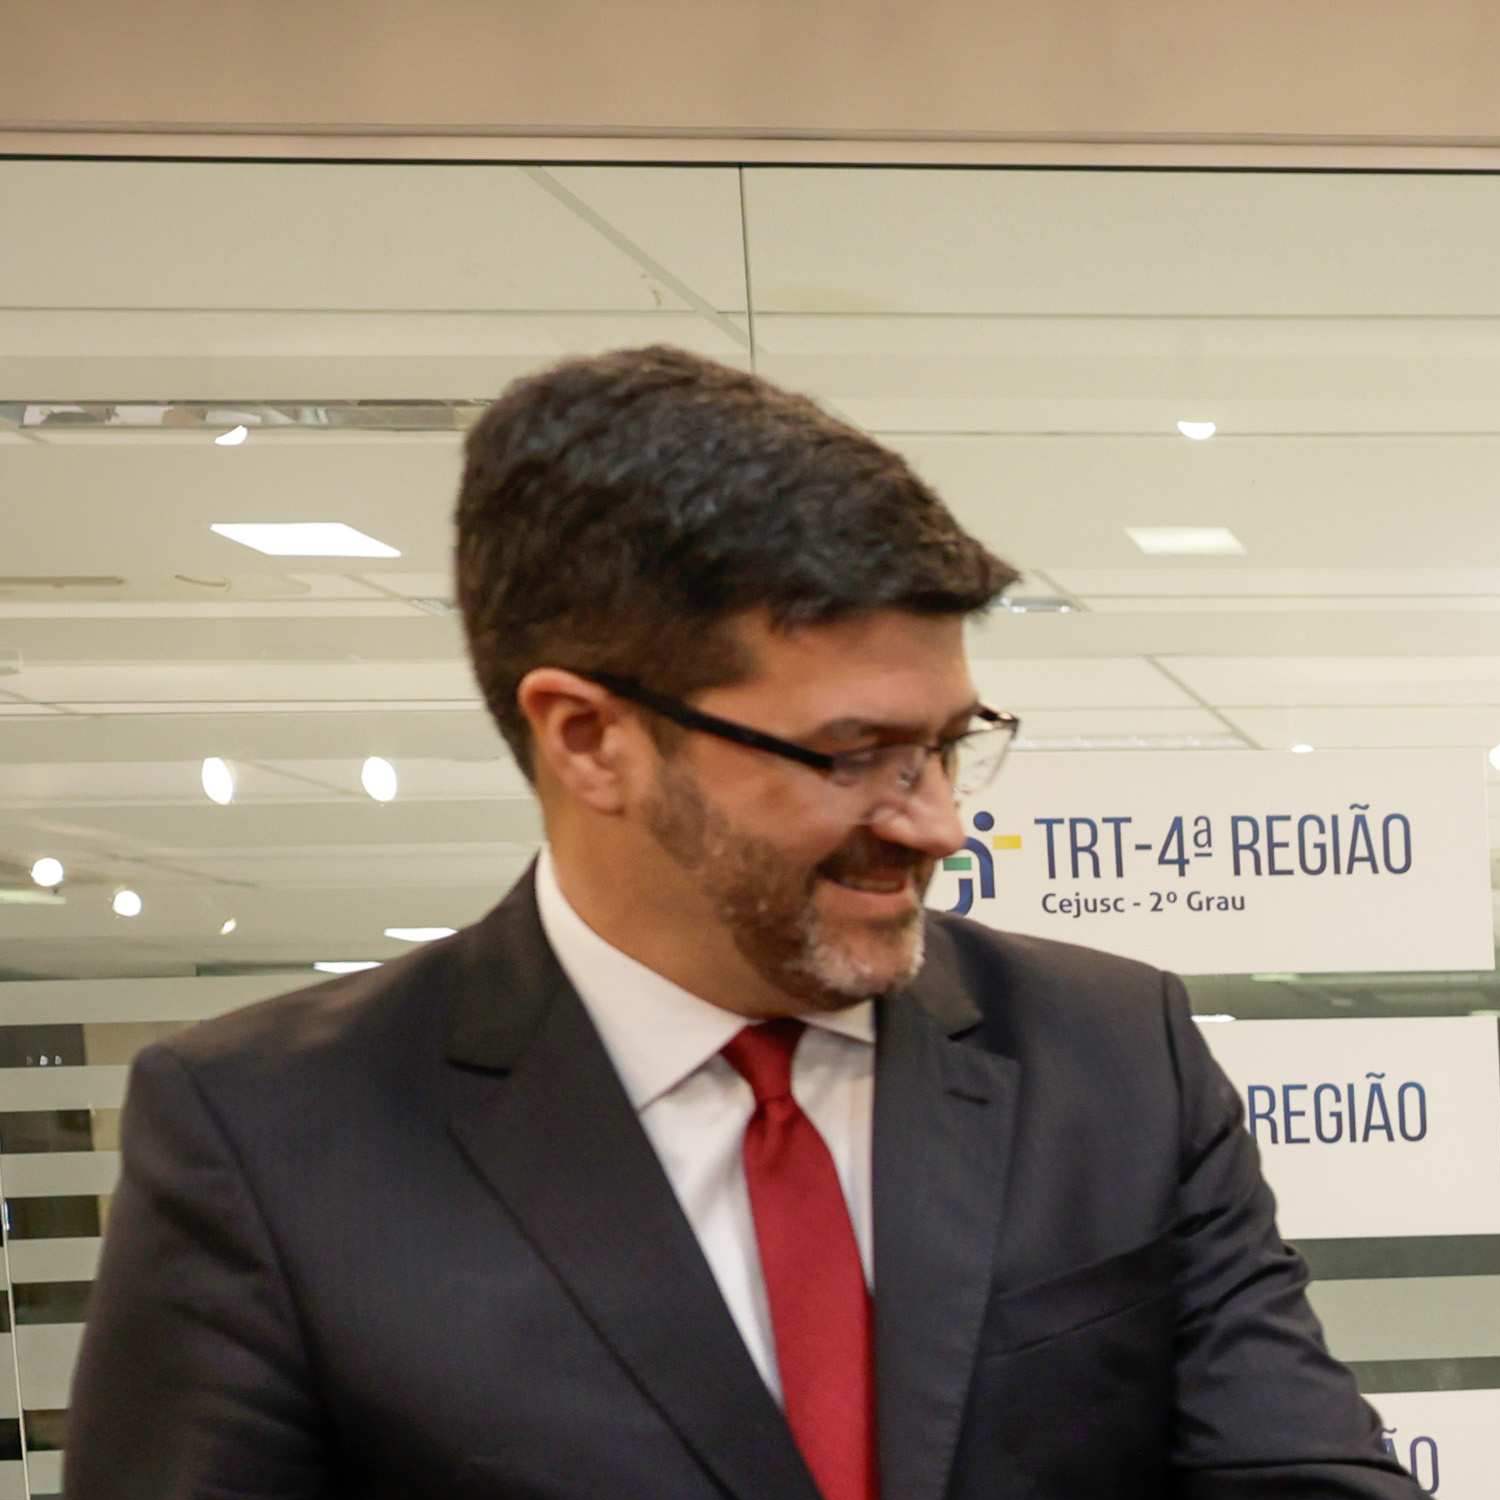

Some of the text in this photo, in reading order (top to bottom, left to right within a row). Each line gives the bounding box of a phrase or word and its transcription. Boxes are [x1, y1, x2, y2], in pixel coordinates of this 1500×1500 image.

[1034, 803, 1412, 879] TRT-4ª REGIÃO
[1041, 893, 1126, 918] Cejusc
[1150, 892, 1178, 912] 2º
[1186, 891, 1246, 911] Grau
[1247, 1072, 1428, 1144] REGIÃO
